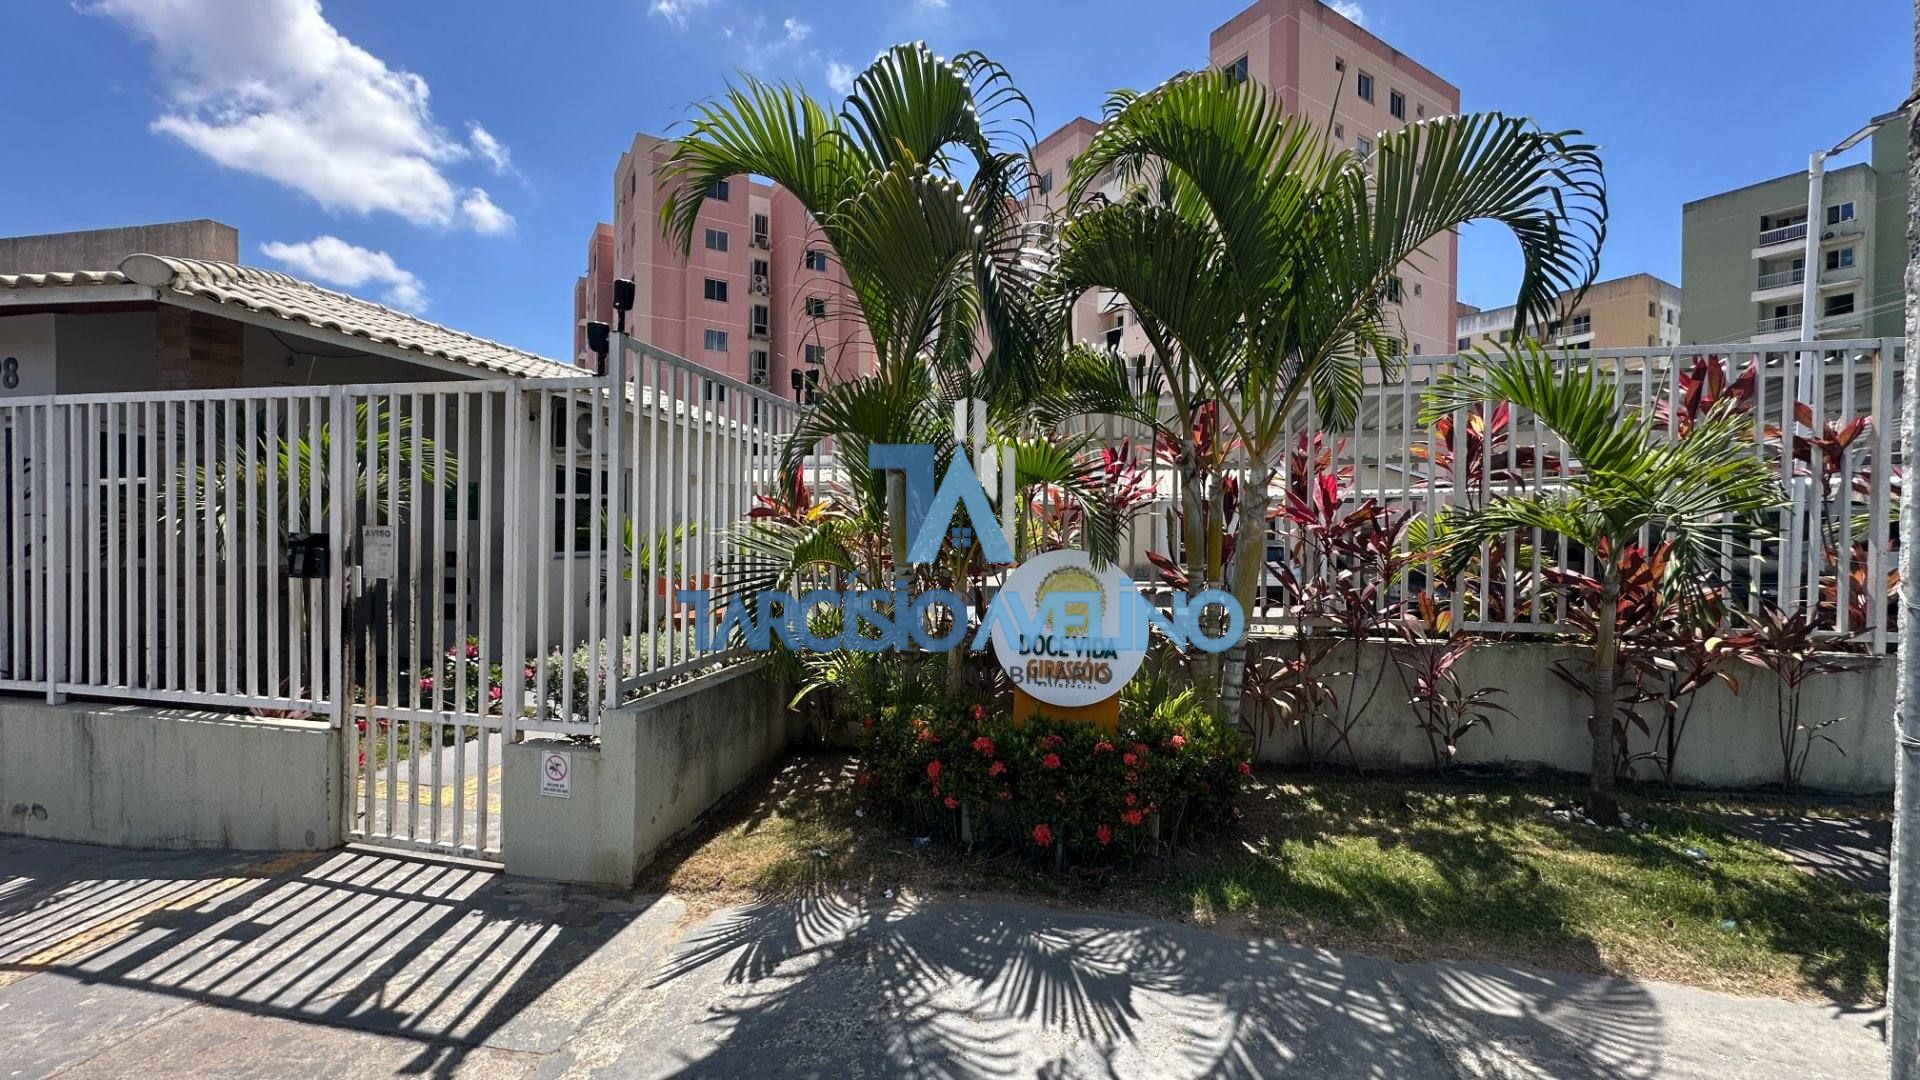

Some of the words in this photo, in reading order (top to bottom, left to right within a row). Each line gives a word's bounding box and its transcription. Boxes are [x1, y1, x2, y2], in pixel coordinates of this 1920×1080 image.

[0, 356, 19, 389] 8
[364, 529, 391, 538] AVISO
[1019, 634, 1070, 656] DOCE
[1073, 636, 1118, 659] VIDA
